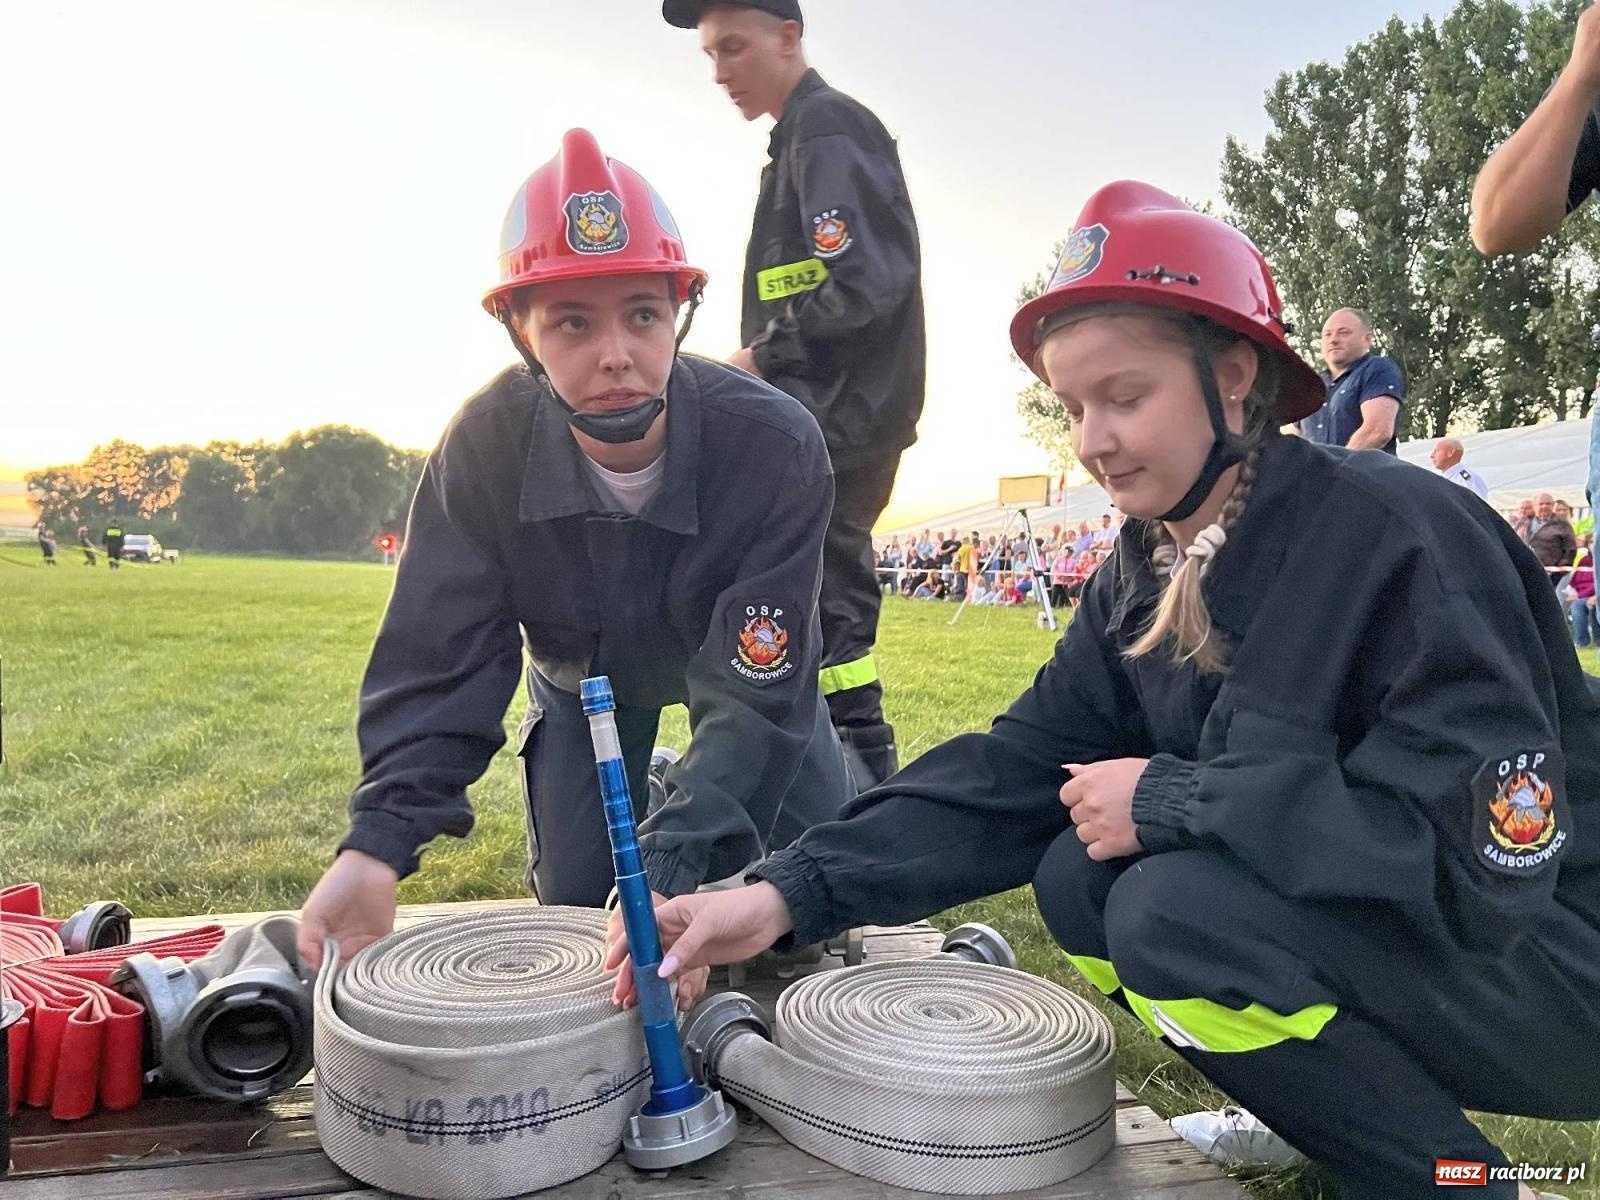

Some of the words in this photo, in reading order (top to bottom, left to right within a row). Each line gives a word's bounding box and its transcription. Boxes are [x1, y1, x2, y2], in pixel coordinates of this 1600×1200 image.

[581, 196, 604, 204] OSP
[746, 605, 783, 619] OSP
[1498, 753, 1545, 776] OSP
[1483, 829, 1567, 867] SAMBOROWICE
